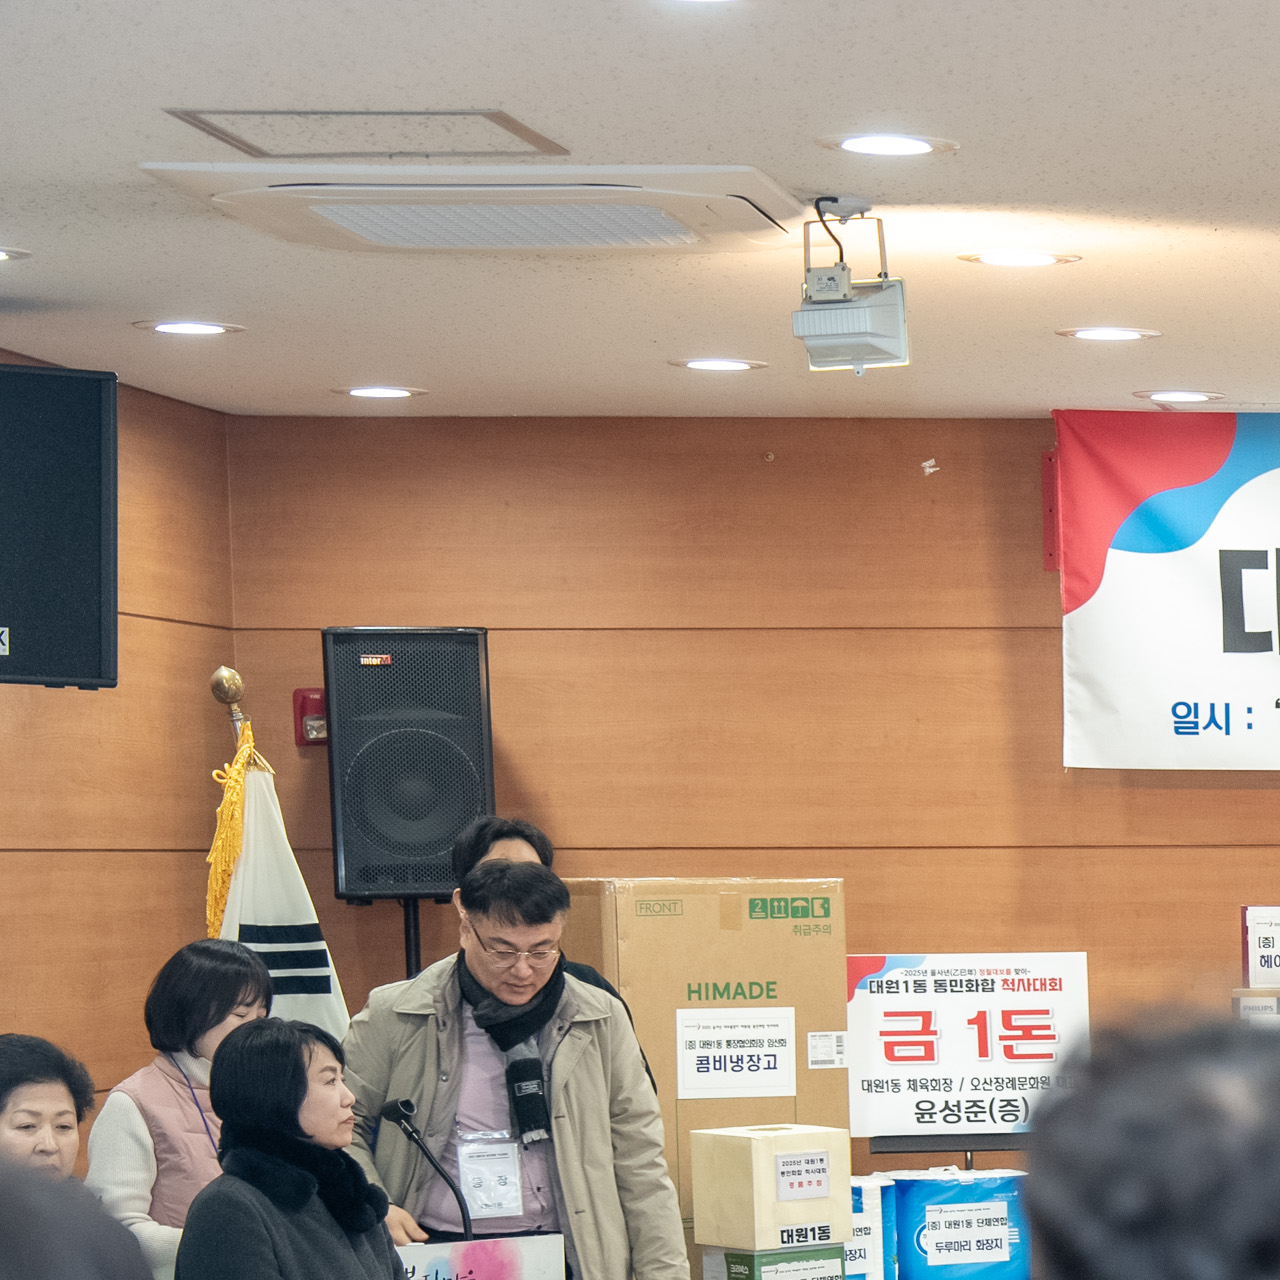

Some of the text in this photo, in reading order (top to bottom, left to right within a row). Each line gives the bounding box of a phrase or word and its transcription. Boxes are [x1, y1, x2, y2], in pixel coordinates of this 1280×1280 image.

[1171, 702, 1232, 737] 일시
[638, 902, 679, 914] FRONT
[792, 924, 832, 936] 취급주의
[687, 981, 778, 1001] HIMADE
[869, 977, 1063, 994] 대원1동 동민화합 척사대회
[879, 1010, 938, 1062] 금
[696, 1054, 778, 1073] 콤비냉장고
[861, 1079, 901, 1093] 대원1동
[907, 1078, 953, 1092] 체육회장
[914, 1097, 1029, 1123] 윤성준(증)
[945, 1217, 1007, 1229] 대원1동 단체연합
[780, 1225, 831, 1245] 대원1동
[935, 1238, 1003, 1254] 두루마리 화장지
